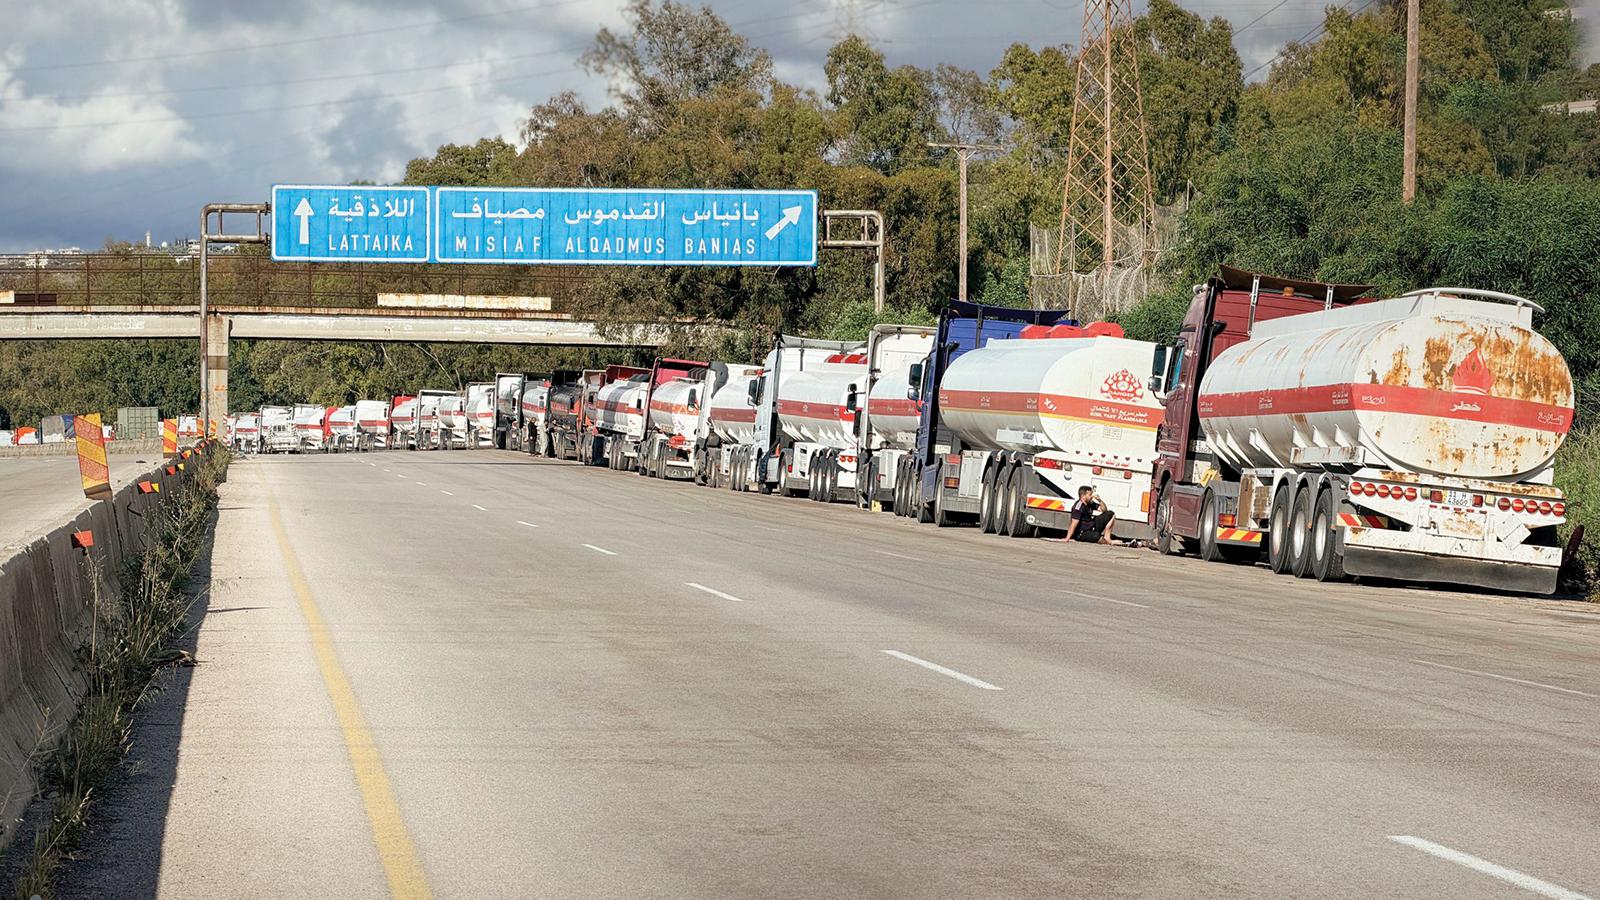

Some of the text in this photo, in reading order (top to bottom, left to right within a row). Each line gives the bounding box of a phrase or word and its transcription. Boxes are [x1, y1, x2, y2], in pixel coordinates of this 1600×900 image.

[328, 195, 415, 222] اللاذقية
[451, 197, 760, 227] بانياس القدموس مصياف
[328, 234, 413, 252] LATTAIKA
[455, 235, 755, 255] MISIAF ALQADMUS BANIAS
[1450, 400, 1481, 412] خطر
